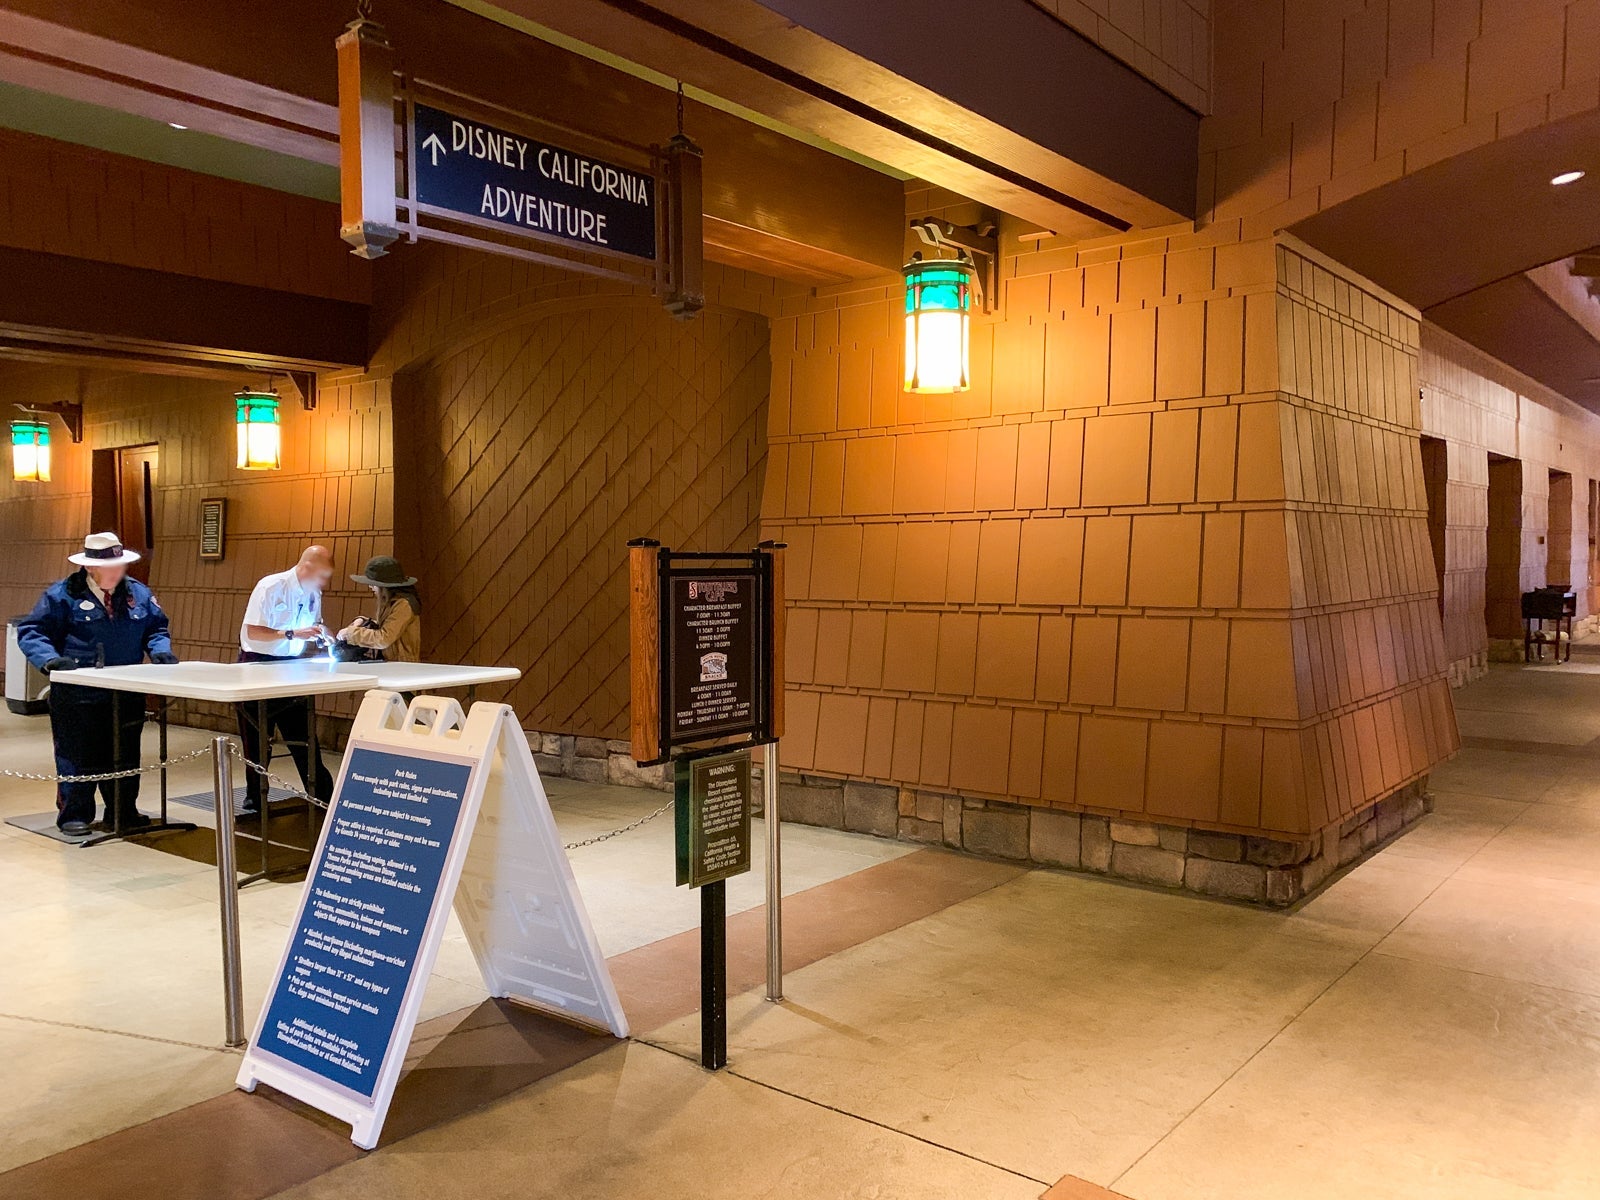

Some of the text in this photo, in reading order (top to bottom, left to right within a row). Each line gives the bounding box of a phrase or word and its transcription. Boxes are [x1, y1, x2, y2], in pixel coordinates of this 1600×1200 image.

[452, 120, 649, 207] DISNEY CALIFORNIA
[480, 184, 608, 244] ADVENTURE
[709, 764, 735, 776] WARNING:
